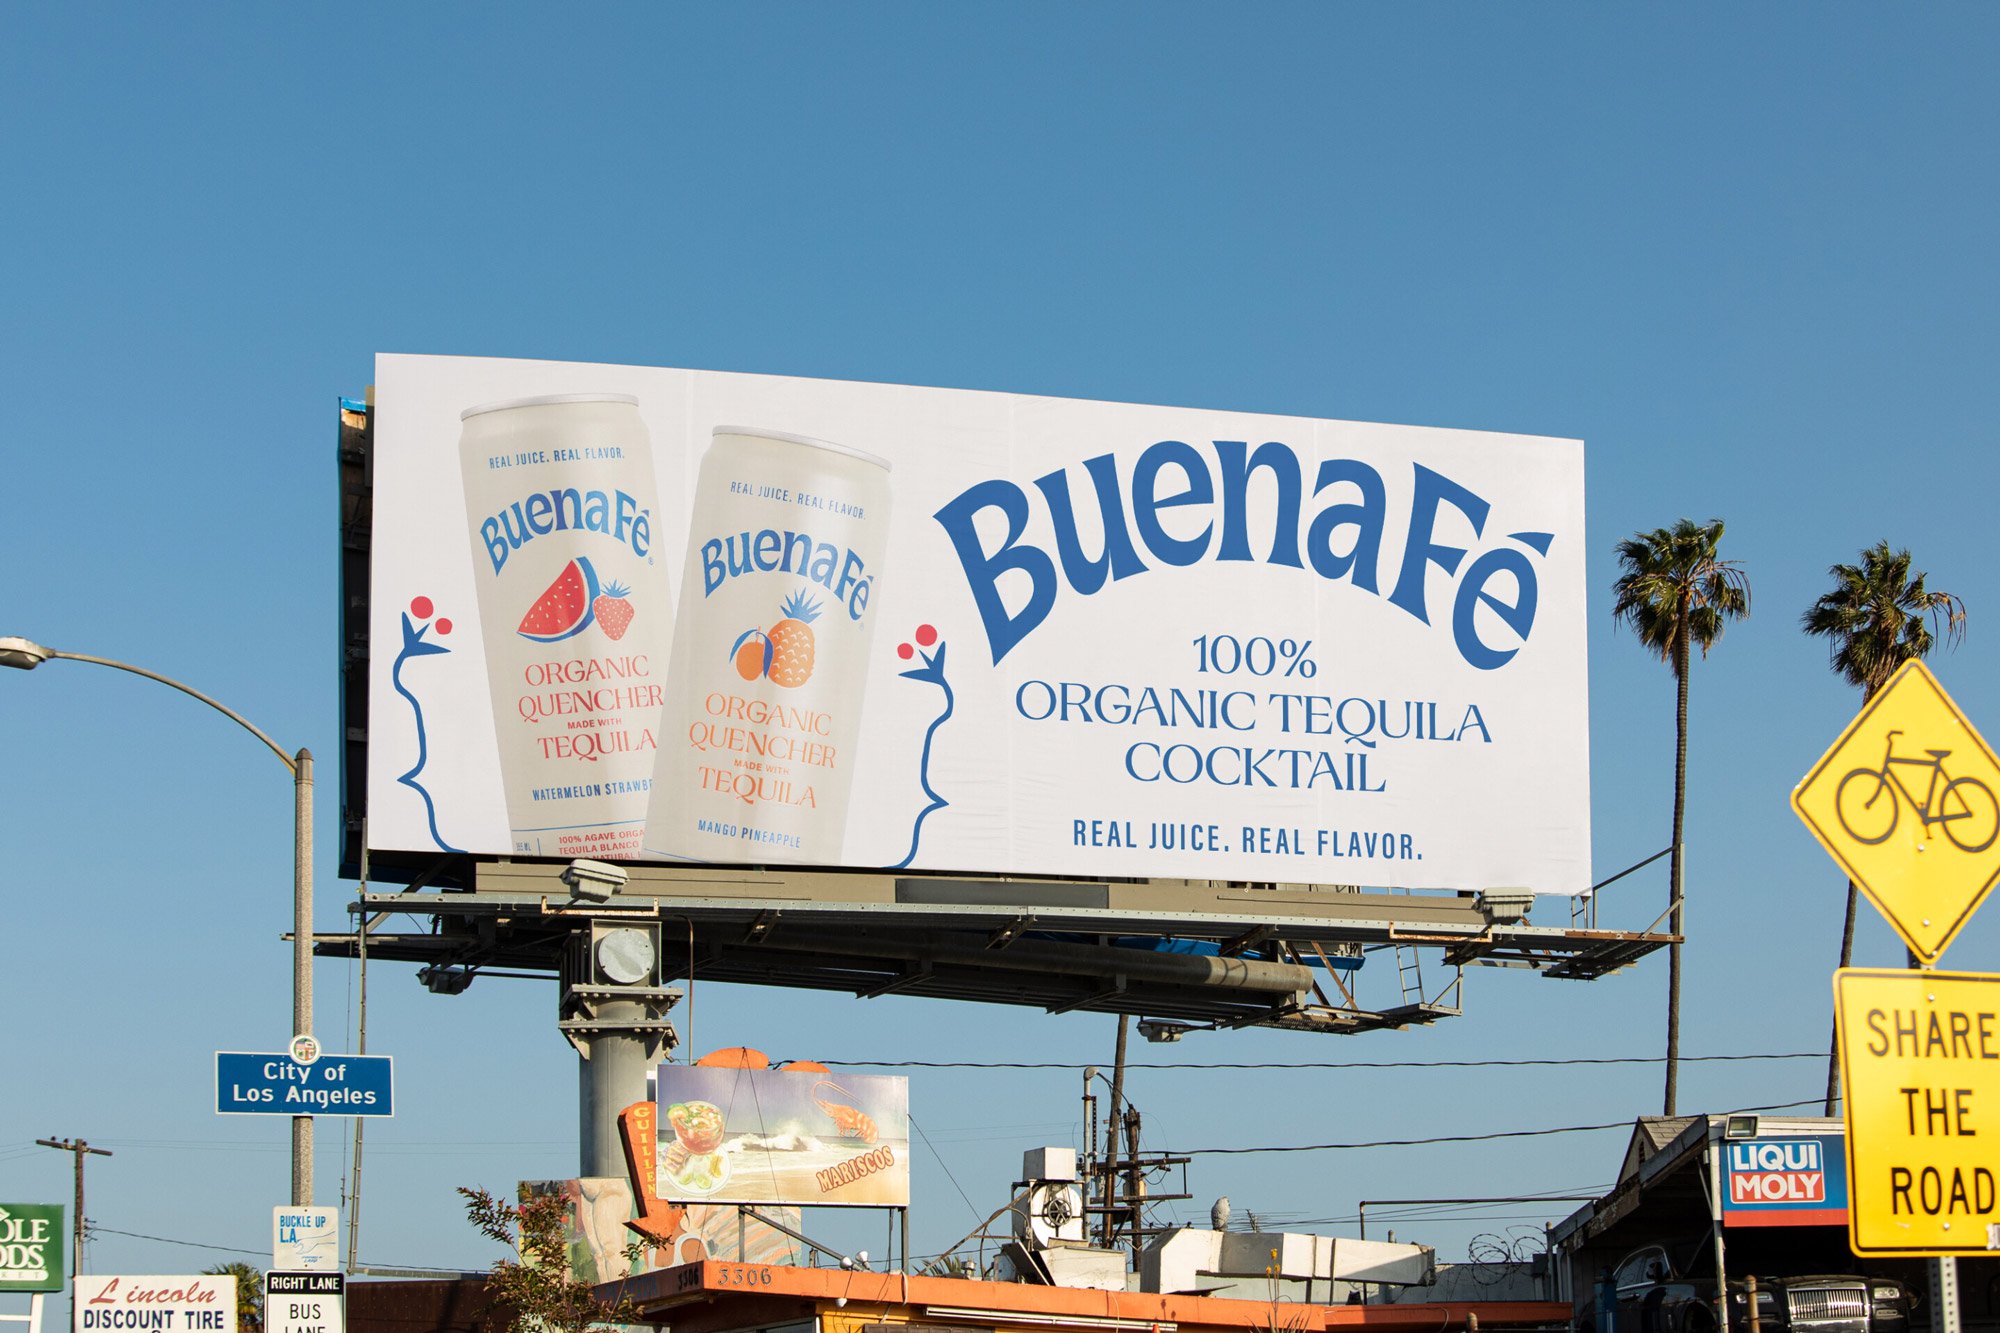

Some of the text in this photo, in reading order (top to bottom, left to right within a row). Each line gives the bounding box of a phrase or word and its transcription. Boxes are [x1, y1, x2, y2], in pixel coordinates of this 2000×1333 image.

[489, 447, 625, 469] REAL JUICE. REAL FLAVOR.
[730, 481, 866, 520] REAL JUICE. REAL FLAVOR.
[525, 655, 649, 687] ORGANIC
[1192, 634, 1318, 679] 100%
[518, 685, 664, 723] QUENCHER
[705, 692, 832, 736] ORGANIC
[1015, 680, 1493, 749] ORGANIC TEQUILA
[567, 718, 622, 730] MADE WITH
[537, 728, 657, 761] TEQUILA
[689, 721, 836, 769] QUENCHER
[733, 758, 790, 775] MADE WITH
[1125, 742, 1387, 793] COCKTAIL
[532, 784, 601, 801] WATERMELON
[698, 766, 816, 809] TEQUILA
[558, 836, 582, 844] 100%
[584, 831, 616, 842] AGAVE
[558, 840, 640, 855] TEQUILA BLANCO
[697, 819, 801, 849] MANGO PINEAPPLE
[1073, 819, 1423, 861] REAL JUICE. REAL FLAVOR.
[1867, 1008, 2000, 1060] SHARE
[263, 1061, 346, 1085] City of
[233, 1083, 377, 1109] Los Angeles
[1899, 1088, 1976, 1137] THE
[633, 1107, 656, 1195] GUILLEN
[1733, 1144, 1817, 1172] LIQUI
[816, 1145, 894, 1192] MARISCOS
[1735, 1173, 1821, 1200] MOLY
[1891, 1166, 1996, 1217] ROAD
[279, 1215, 326, 1227] BUCKLE UP
[89, 1277, 217, 1305] Lincoln
[270, 1277, 340, 1290] RIGHT LANE
[717, 1267, 772, 1286] 3306
[83, 1309, 224, 1329] DISCOUNT TIRE
[289, 1303, 321, 1319] BUS
